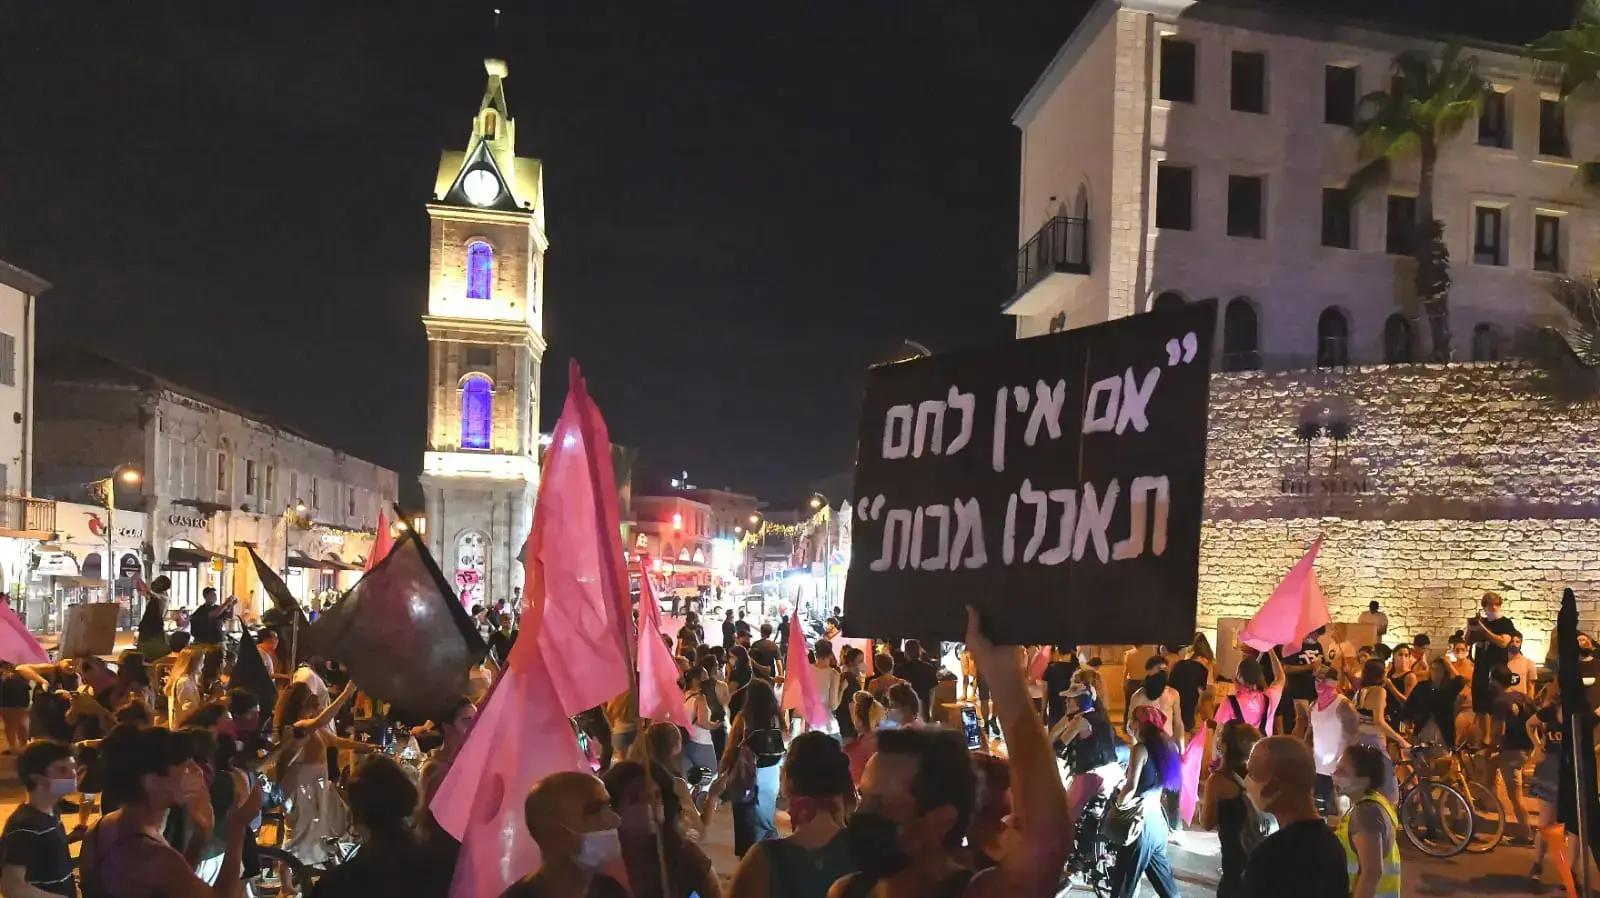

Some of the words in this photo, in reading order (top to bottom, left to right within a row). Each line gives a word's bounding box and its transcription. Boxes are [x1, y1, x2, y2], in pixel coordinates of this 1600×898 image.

[882, 384, 976, 459] לחם
[992, 379, 1066, 472] אין
[169, 514, 207, 528] CASTRO
[1003, 475, 1170, 567] תאכלו
